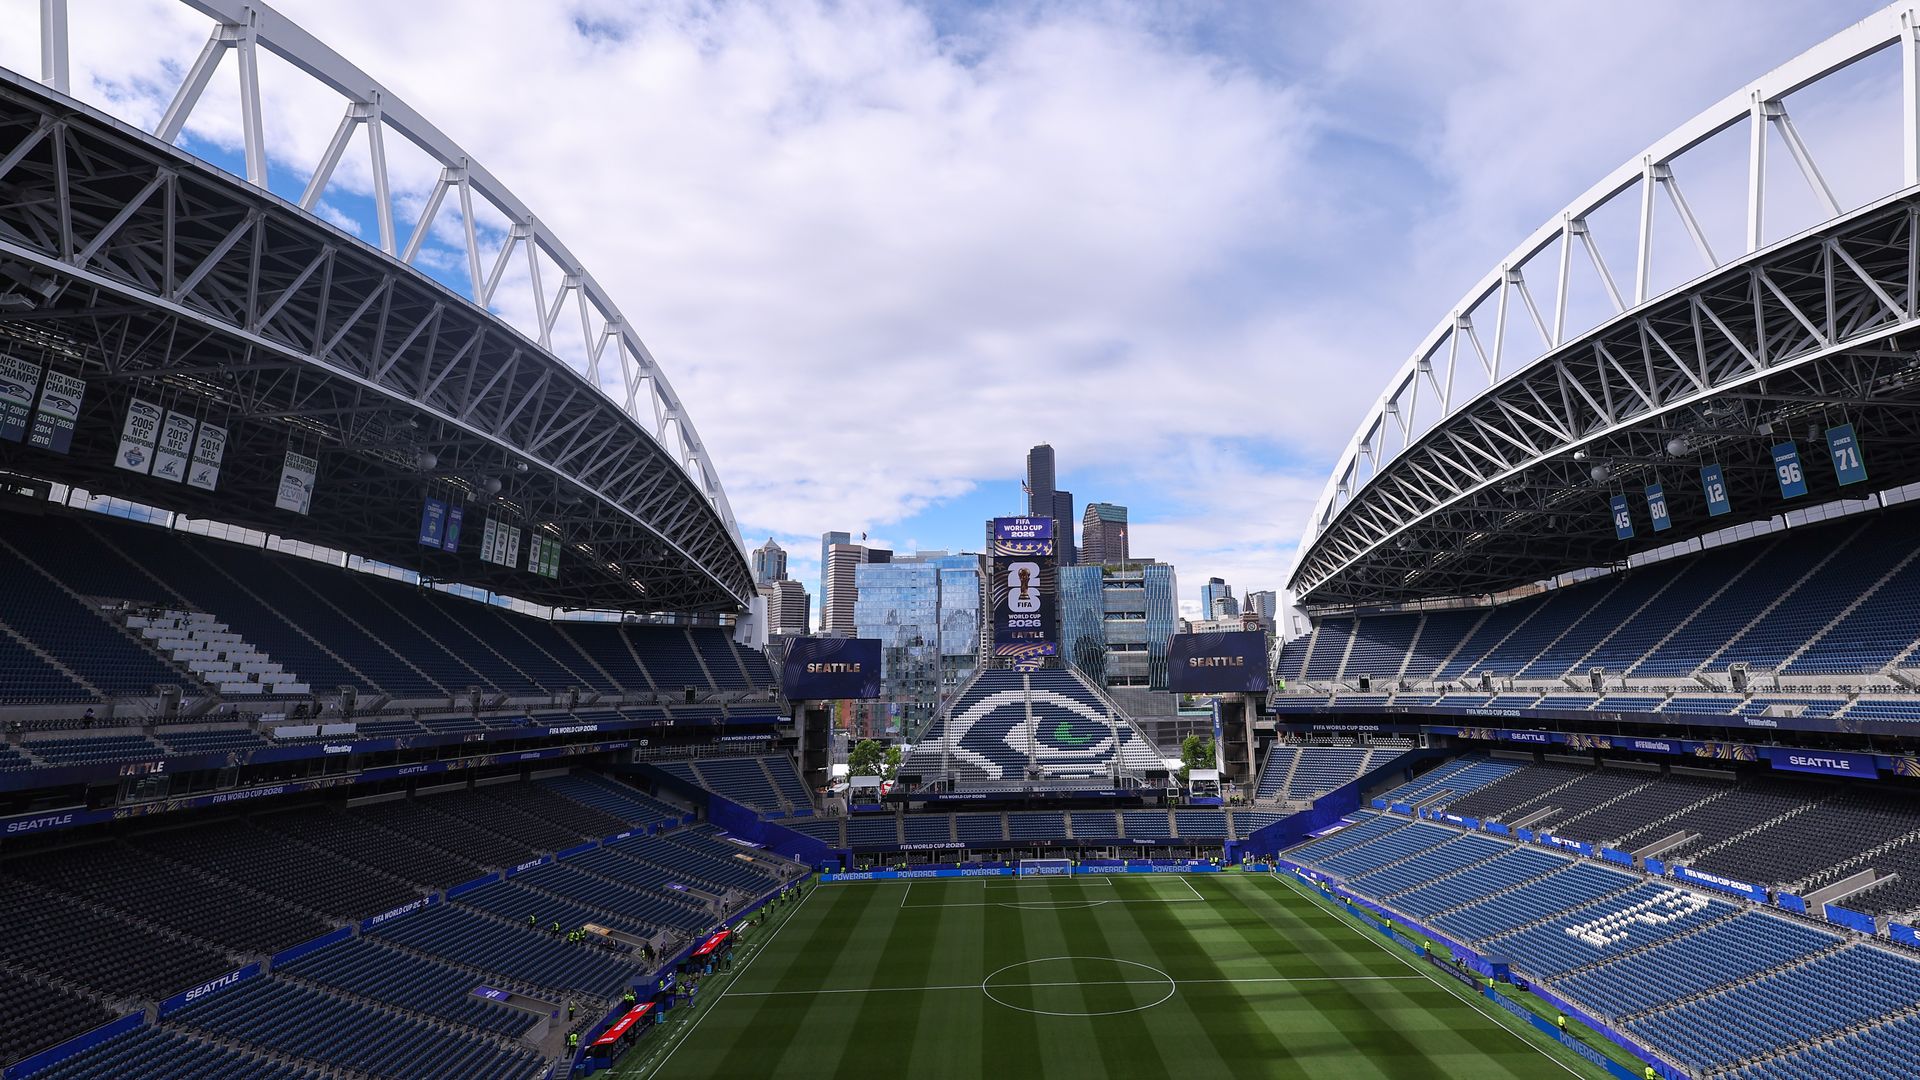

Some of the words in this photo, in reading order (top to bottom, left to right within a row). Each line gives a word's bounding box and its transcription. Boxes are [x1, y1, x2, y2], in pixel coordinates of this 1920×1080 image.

[0, 366, 37, 385] CHAMPS
[19, 362, 40, 375] WEST
[48, 372, 62, 383] NFC
[65, 377, 84, 390] WEST
[46, 380, 82, 400] CHAMPS
[10, 406, 28, 416] 2007
[35, 424, 52, 434] 2014
[38, 414, 55, 424] 2013
[57, 420, 74, 430] 2020
[132, 416, 154, 430] 2005
[32, 434, 50, 445] 2016
[132, 428, 148, 439] NFC
[167, 428, 188, 442] 2013
[122, 434, 154, 448] CHAMPIONS
[168, 439, 184, 450] NFC
[201, 438, 220, 452] 2014
[160, 446, 188, 459] CHAMPIONS
[202, 450, 216, 460] NFC
[1835, 447, 1858, 470] 71
[193, 456, 220, 468] CHAMPIONS
[1779, 462, 1802, 484] 96
[1708, 484, 1724, 504] 12
[1650, 501, 1666, 520] 80
[1616, 512, 1630, 528] 45
[1008, 620, 1042, 628] 2026
[806, 663, 860, 672] SEATTLE
[1190, 656, 1244, 667] SEATTLE
[1512, 733, 1545, 741] SEATTLE
[1635, 740, 1670, 752] #FIFAWorldCup
[398, 765, 428, 774] SEATTLE
[1790, 756, 1850, 770] SEATTLE
[212, 796, 226, 804] FIFA
[228, 791, 250, 800] WORLD
[250, 790, 262, 798] CUP
[262, 786, 283, 796] 2026
[7, 814, 72, 833] SEATTLE
[1552, 836, 1580, 848] SETTLE
[517, 858, 542, 872] SEATTLE
[961, 868, 1000, 876] POWERADE
[1025, 866, 1065, 874] POWERADE
[1152, 864, 1192, 872] POWERADE
[833, 872, 873, 880] POWERADE
[898, 870, 937, 878] POWERADE
[1684, 868, 1696, 878] FIFA
[1697, 872, 1718, 883] WORLD
[1718, 877, 1730, 886] CUP
[1730, 881, 1753, 892] 2026
[372, 914, 384, 924] FIFA
[384, 908, 402, 920] WORLD
[403, 904, 412, 912] CUP
[185, 971, 240, 1002] SEATTLE
[1494, 992, 1532, 1024] POWERADE
[1560, 1030, 1608, 1070] POWERADE
